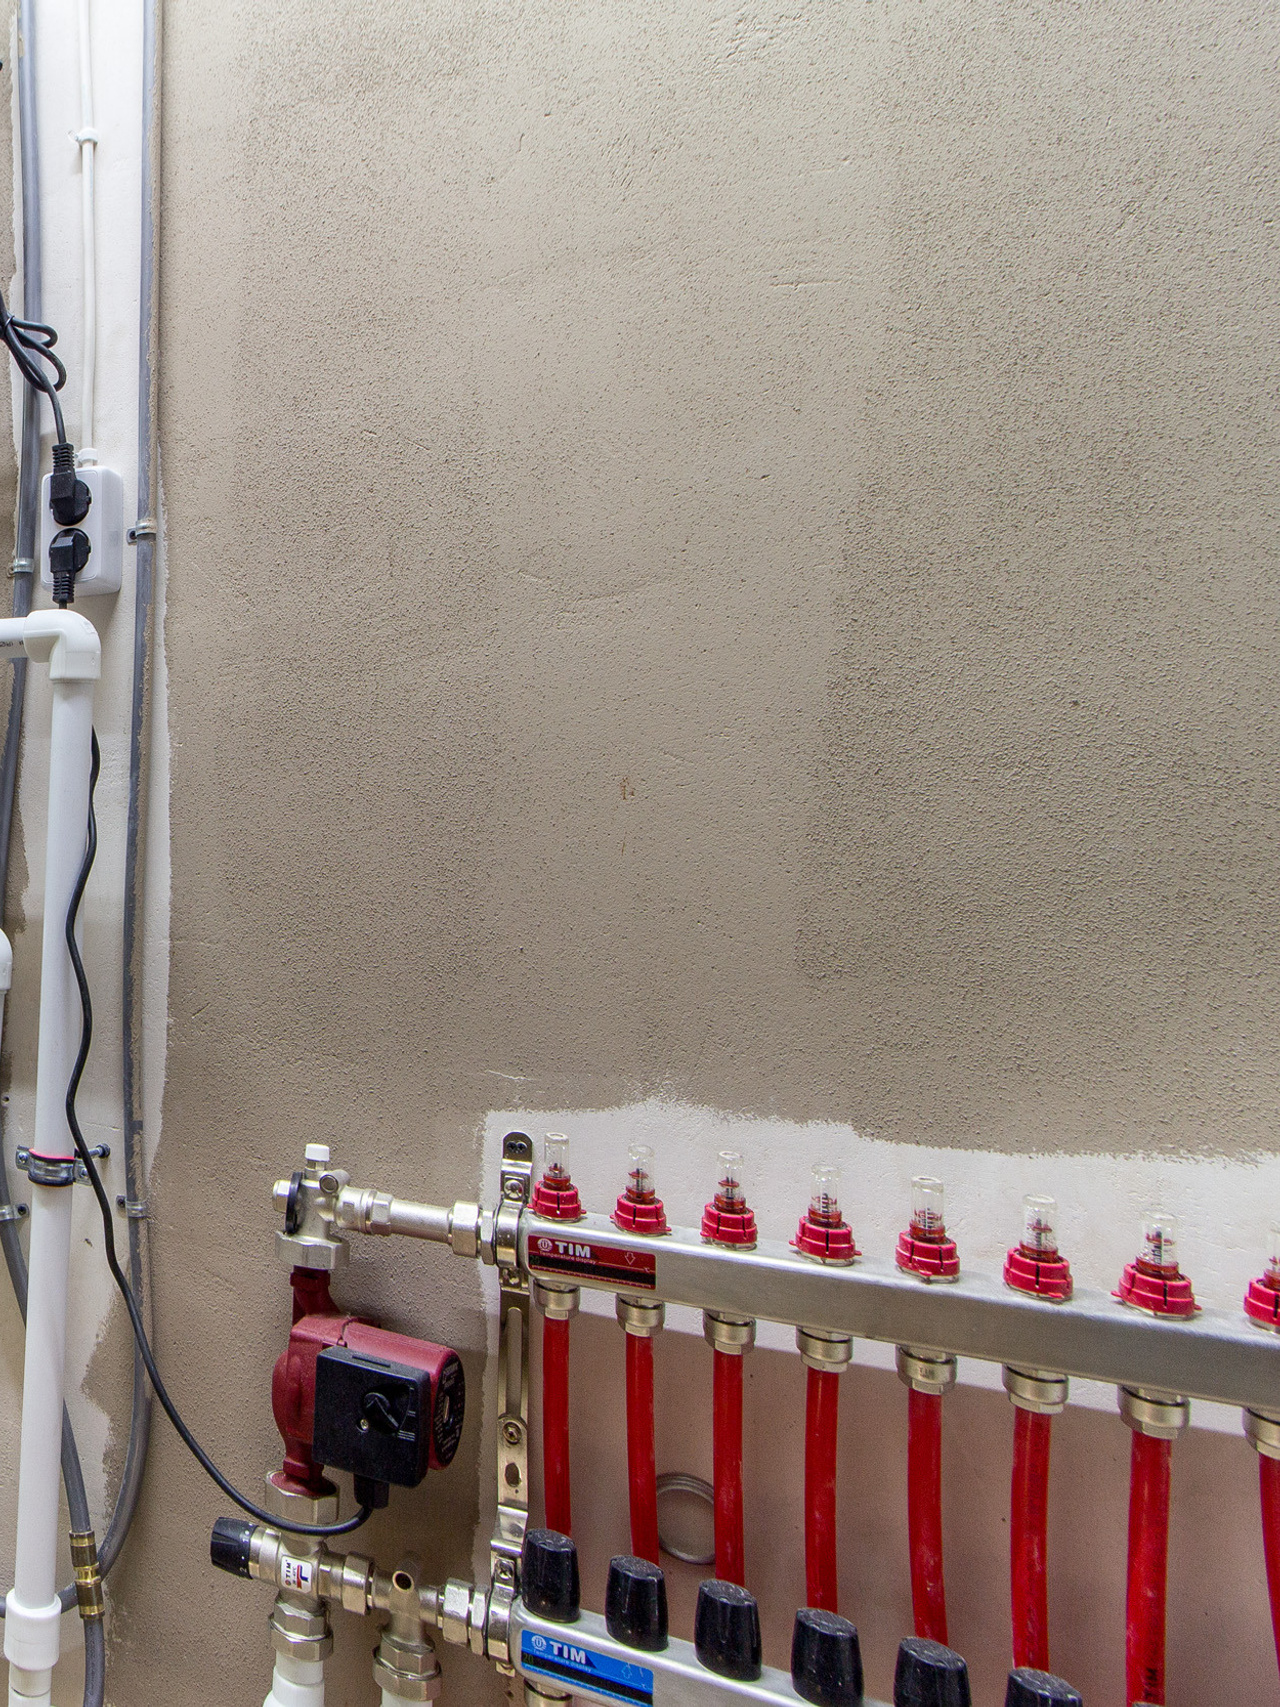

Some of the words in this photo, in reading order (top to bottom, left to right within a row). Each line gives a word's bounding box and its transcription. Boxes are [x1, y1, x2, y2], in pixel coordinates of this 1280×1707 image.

[540, 1251, 574, 1262] Temperature
[575, 1257, 596, 1265] display
[555, 1241, 591, 1258] TIM
[533, 1648, 569, 1667] Temperature
[549, 1641, 587, 1664] TIM
